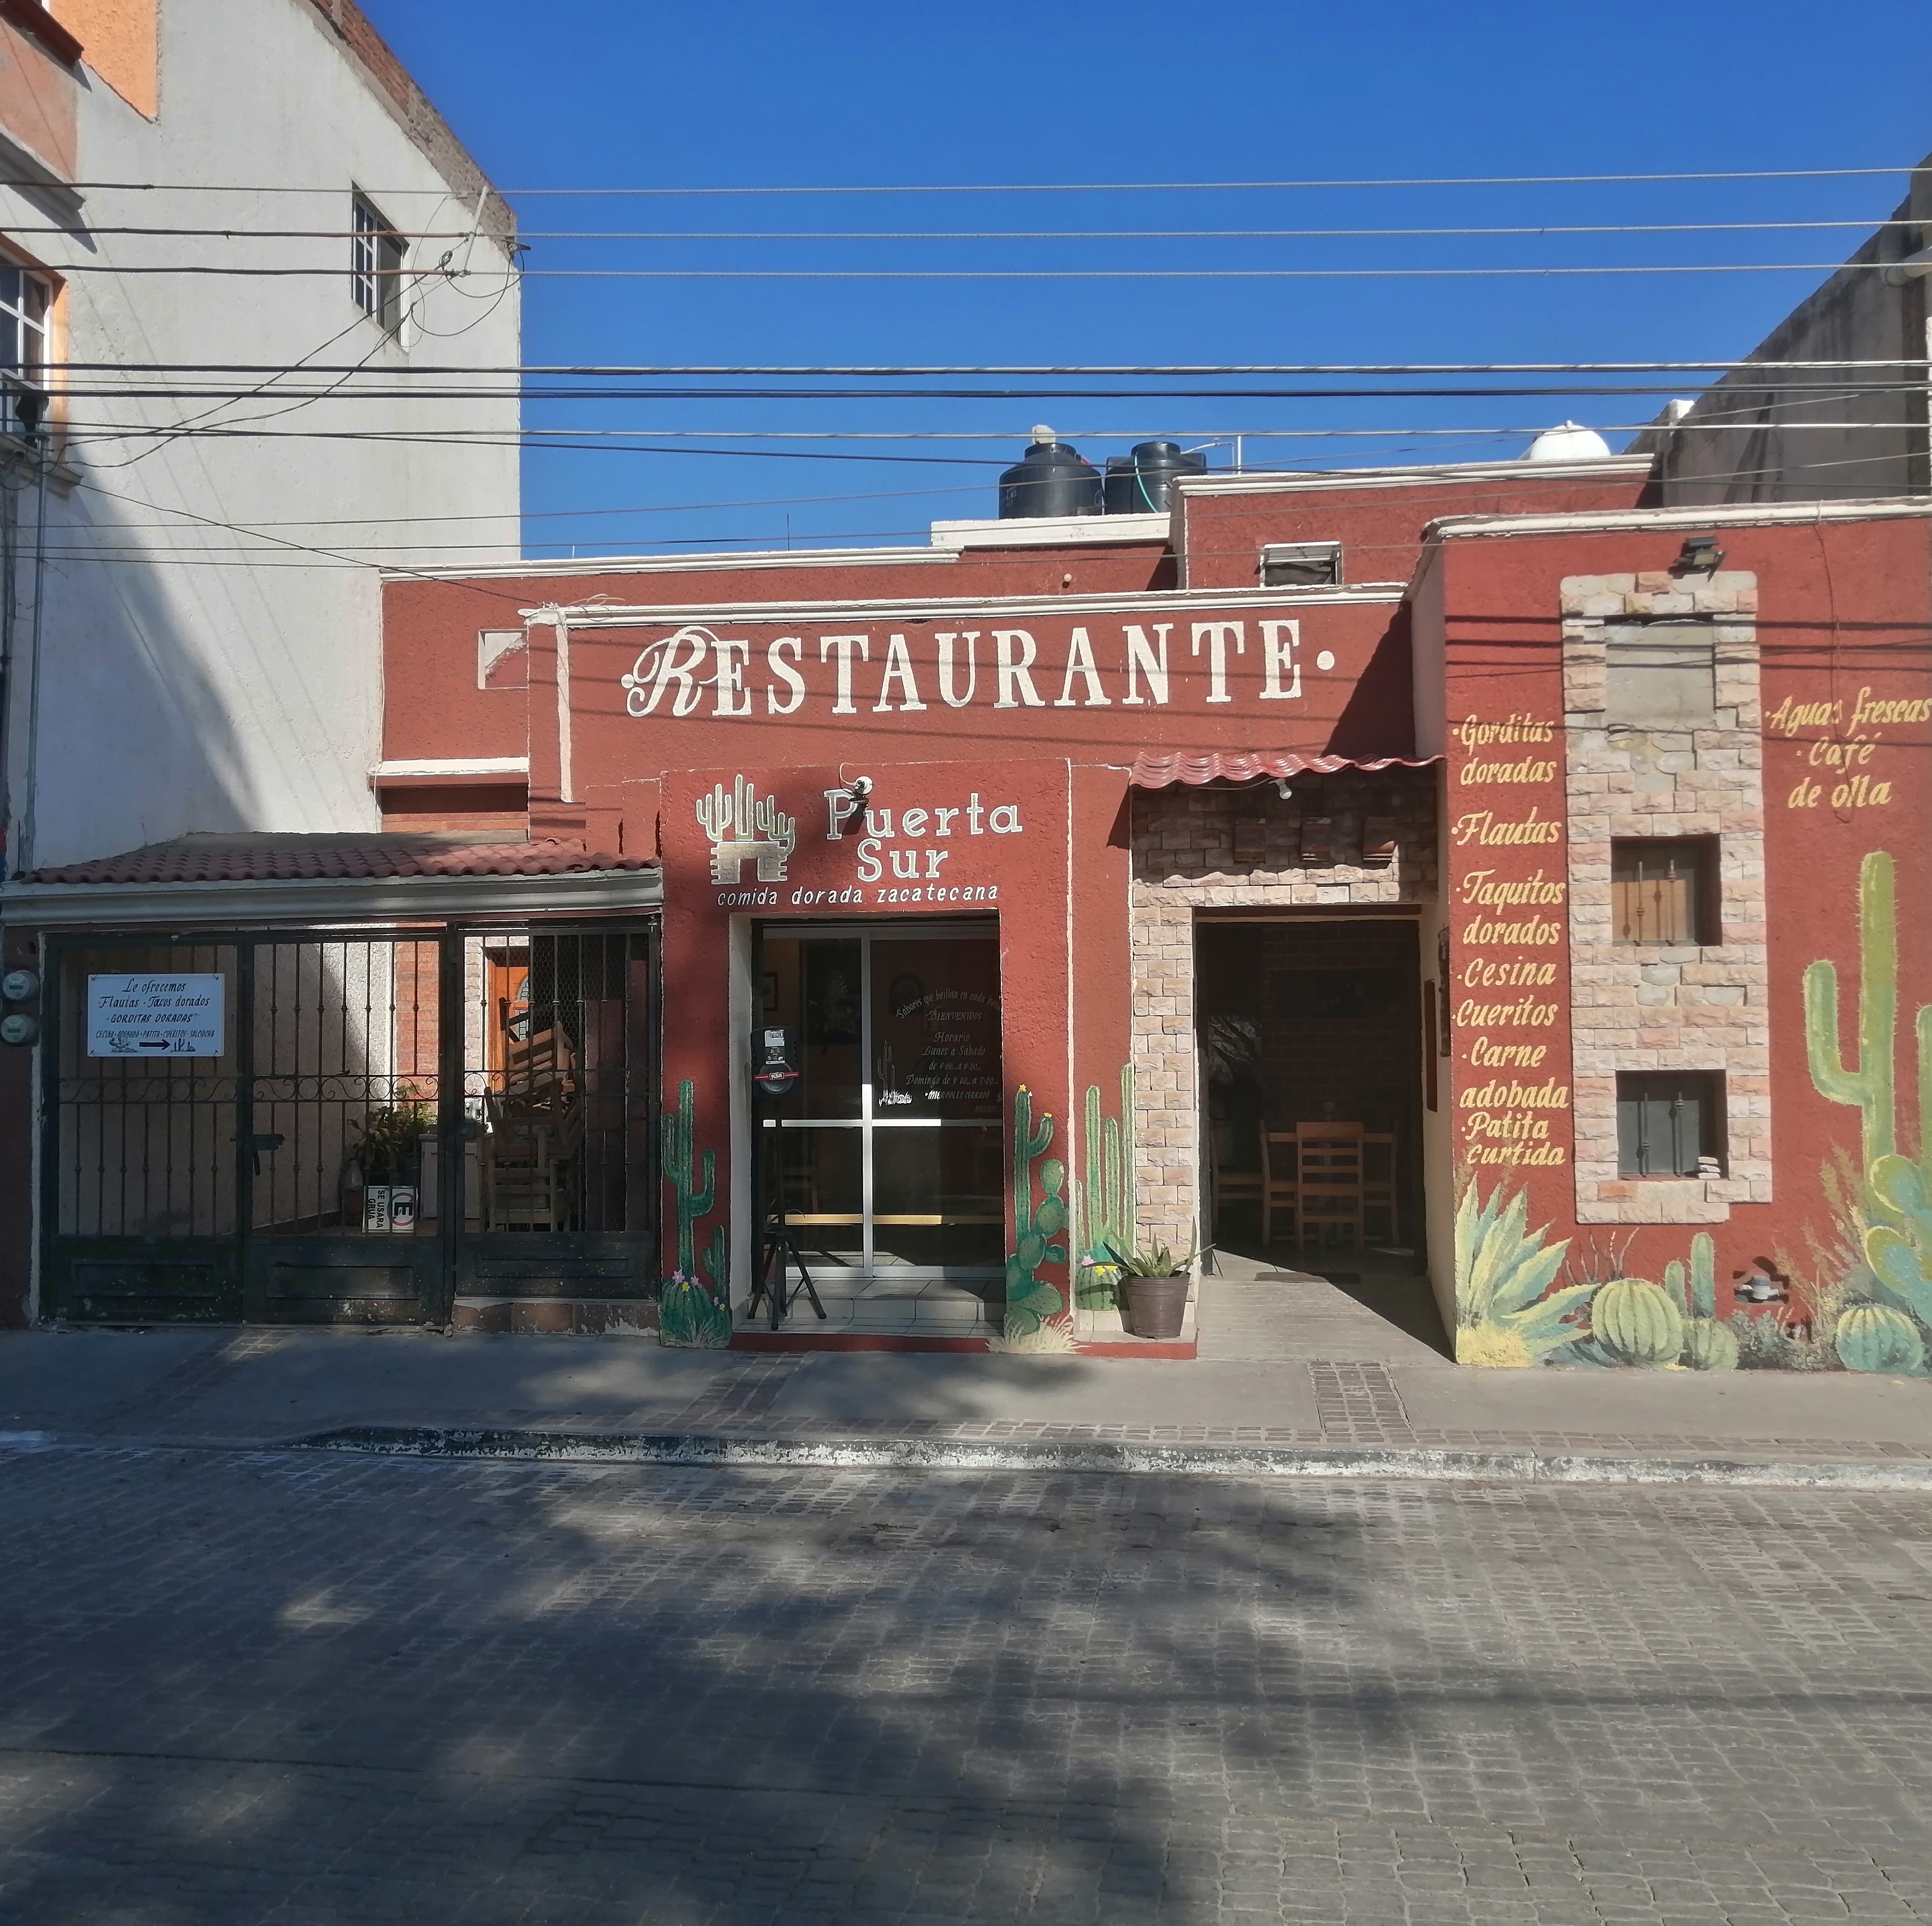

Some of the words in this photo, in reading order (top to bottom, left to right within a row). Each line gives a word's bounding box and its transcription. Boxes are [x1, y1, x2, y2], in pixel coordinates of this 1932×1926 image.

[621, 618, 1302, 718] RESTAURANTE
[1770, 695, 1843, 737] Aguas
[1846, 685, 1932, 737] frescas
[1461, 713, 1554, 756] Gorditas
[1809, 732, 1883, 775] Café
[1460, 756, 1557, 786] doradas
[1788, 777, 1822, 809] de
[1831, 775, 1892, 808] olla
[824, 787, 1023, 840] Puerta
[1456, 806, 1562, 846] Flautas
[857, 838, 948, 882] Sur
[717, 887, 777, 906] comida
[792, 885, 862, 905] dorada
[877, 882, 998, 903] zacatecana
[1462, 869, 1565, 915] Taquitos
[1462, 914, 1561, 945] dorados
[122, 978, 138, 992] Le
[141, 979, 186, 995] ofrecemos
[1464, 956, 1557, 988] Cesina
[99, 995, 140, 1009] Flautas
[148, 995, 172, 1008] Tacos
[175, 994, 210, 1007] dorados
[895, 997, 923, 1019] Sabores
[923, 994, 934, 1006] que
[960, 991, 968, 999] en
[970, 993, 985, 1004] cada
[927, 1006, 982, 1021] BIENVENIDOS
[1456, 994, 1558, 1027] Cueritos
[111, 1013, 151, 1023] GORDITAS
[155, 1013, 193, 1023] DORADAS
[921, 1045, 948, 1056] Lunes
[933, 1031, 970, 1043] Horario
[1471, 1036, 1547, 1068] Carne
[928, 1058, 938, 1071] de
[905, 1073, 940, 1089] Domingo
[942, 1074, 951, 1085] de
[972, 1077, 978, 1085] a
[1459, 1077, 1569, 1108] adobada
[1465, 1110, 1549, 1140] Patita
[1466, 1141, 1566, 1165] curtida
[378, 1190, 385, 1200] SE
[394, 1202, 413, 1216] E
[376, 1202, 385, 1228] USARA
